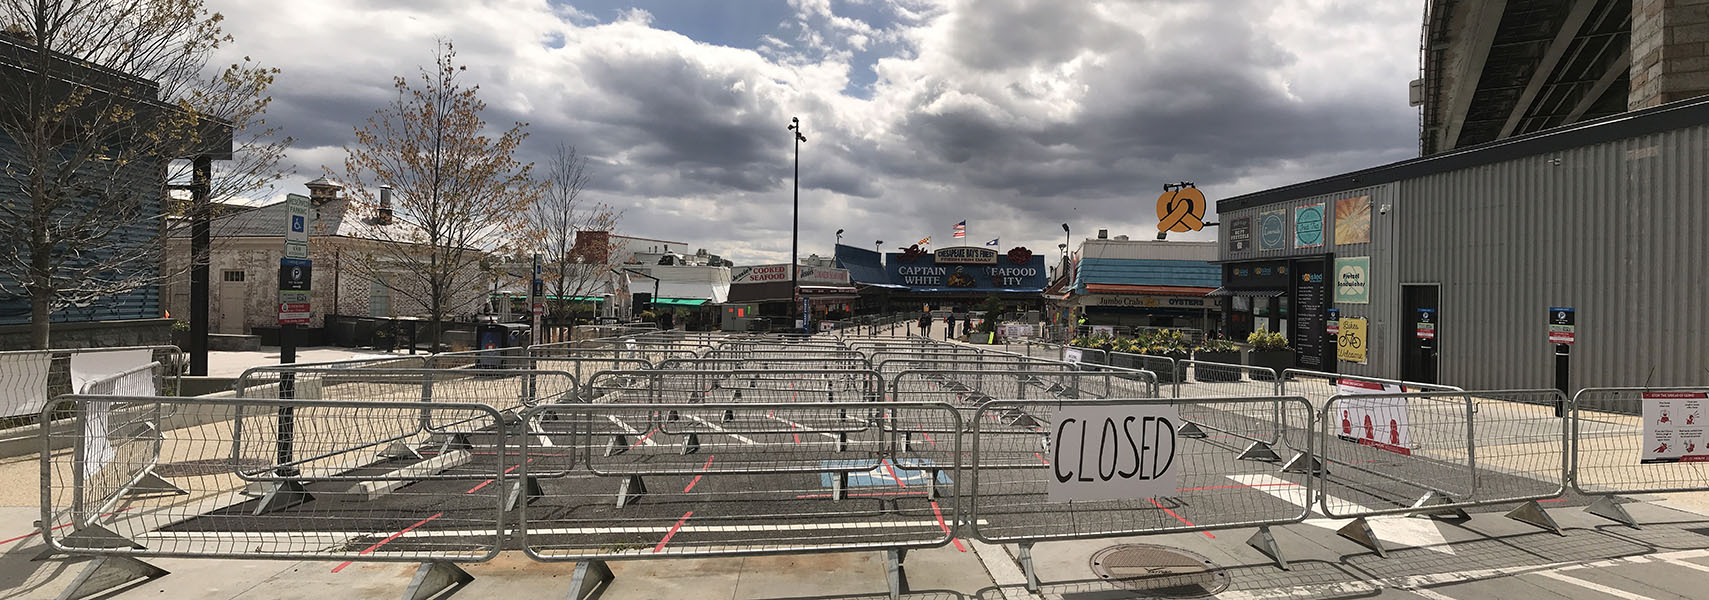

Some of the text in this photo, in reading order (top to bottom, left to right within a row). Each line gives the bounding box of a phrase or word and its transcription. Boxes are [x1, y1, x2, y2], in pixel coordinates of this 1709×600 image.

[753, 266, 785, 274] COOKED
[898, 266, 947, 276] CAPTAIN
[750, 273, 785, 281] SEAFOOD
[904, 276, 941, 285] WHITE
[1100, 296, 1144, 306] Jumbo Crabs
[1169, 298, 1204, 306] OYSTERS
[1054, 416, 1177, 483] CLOSED
